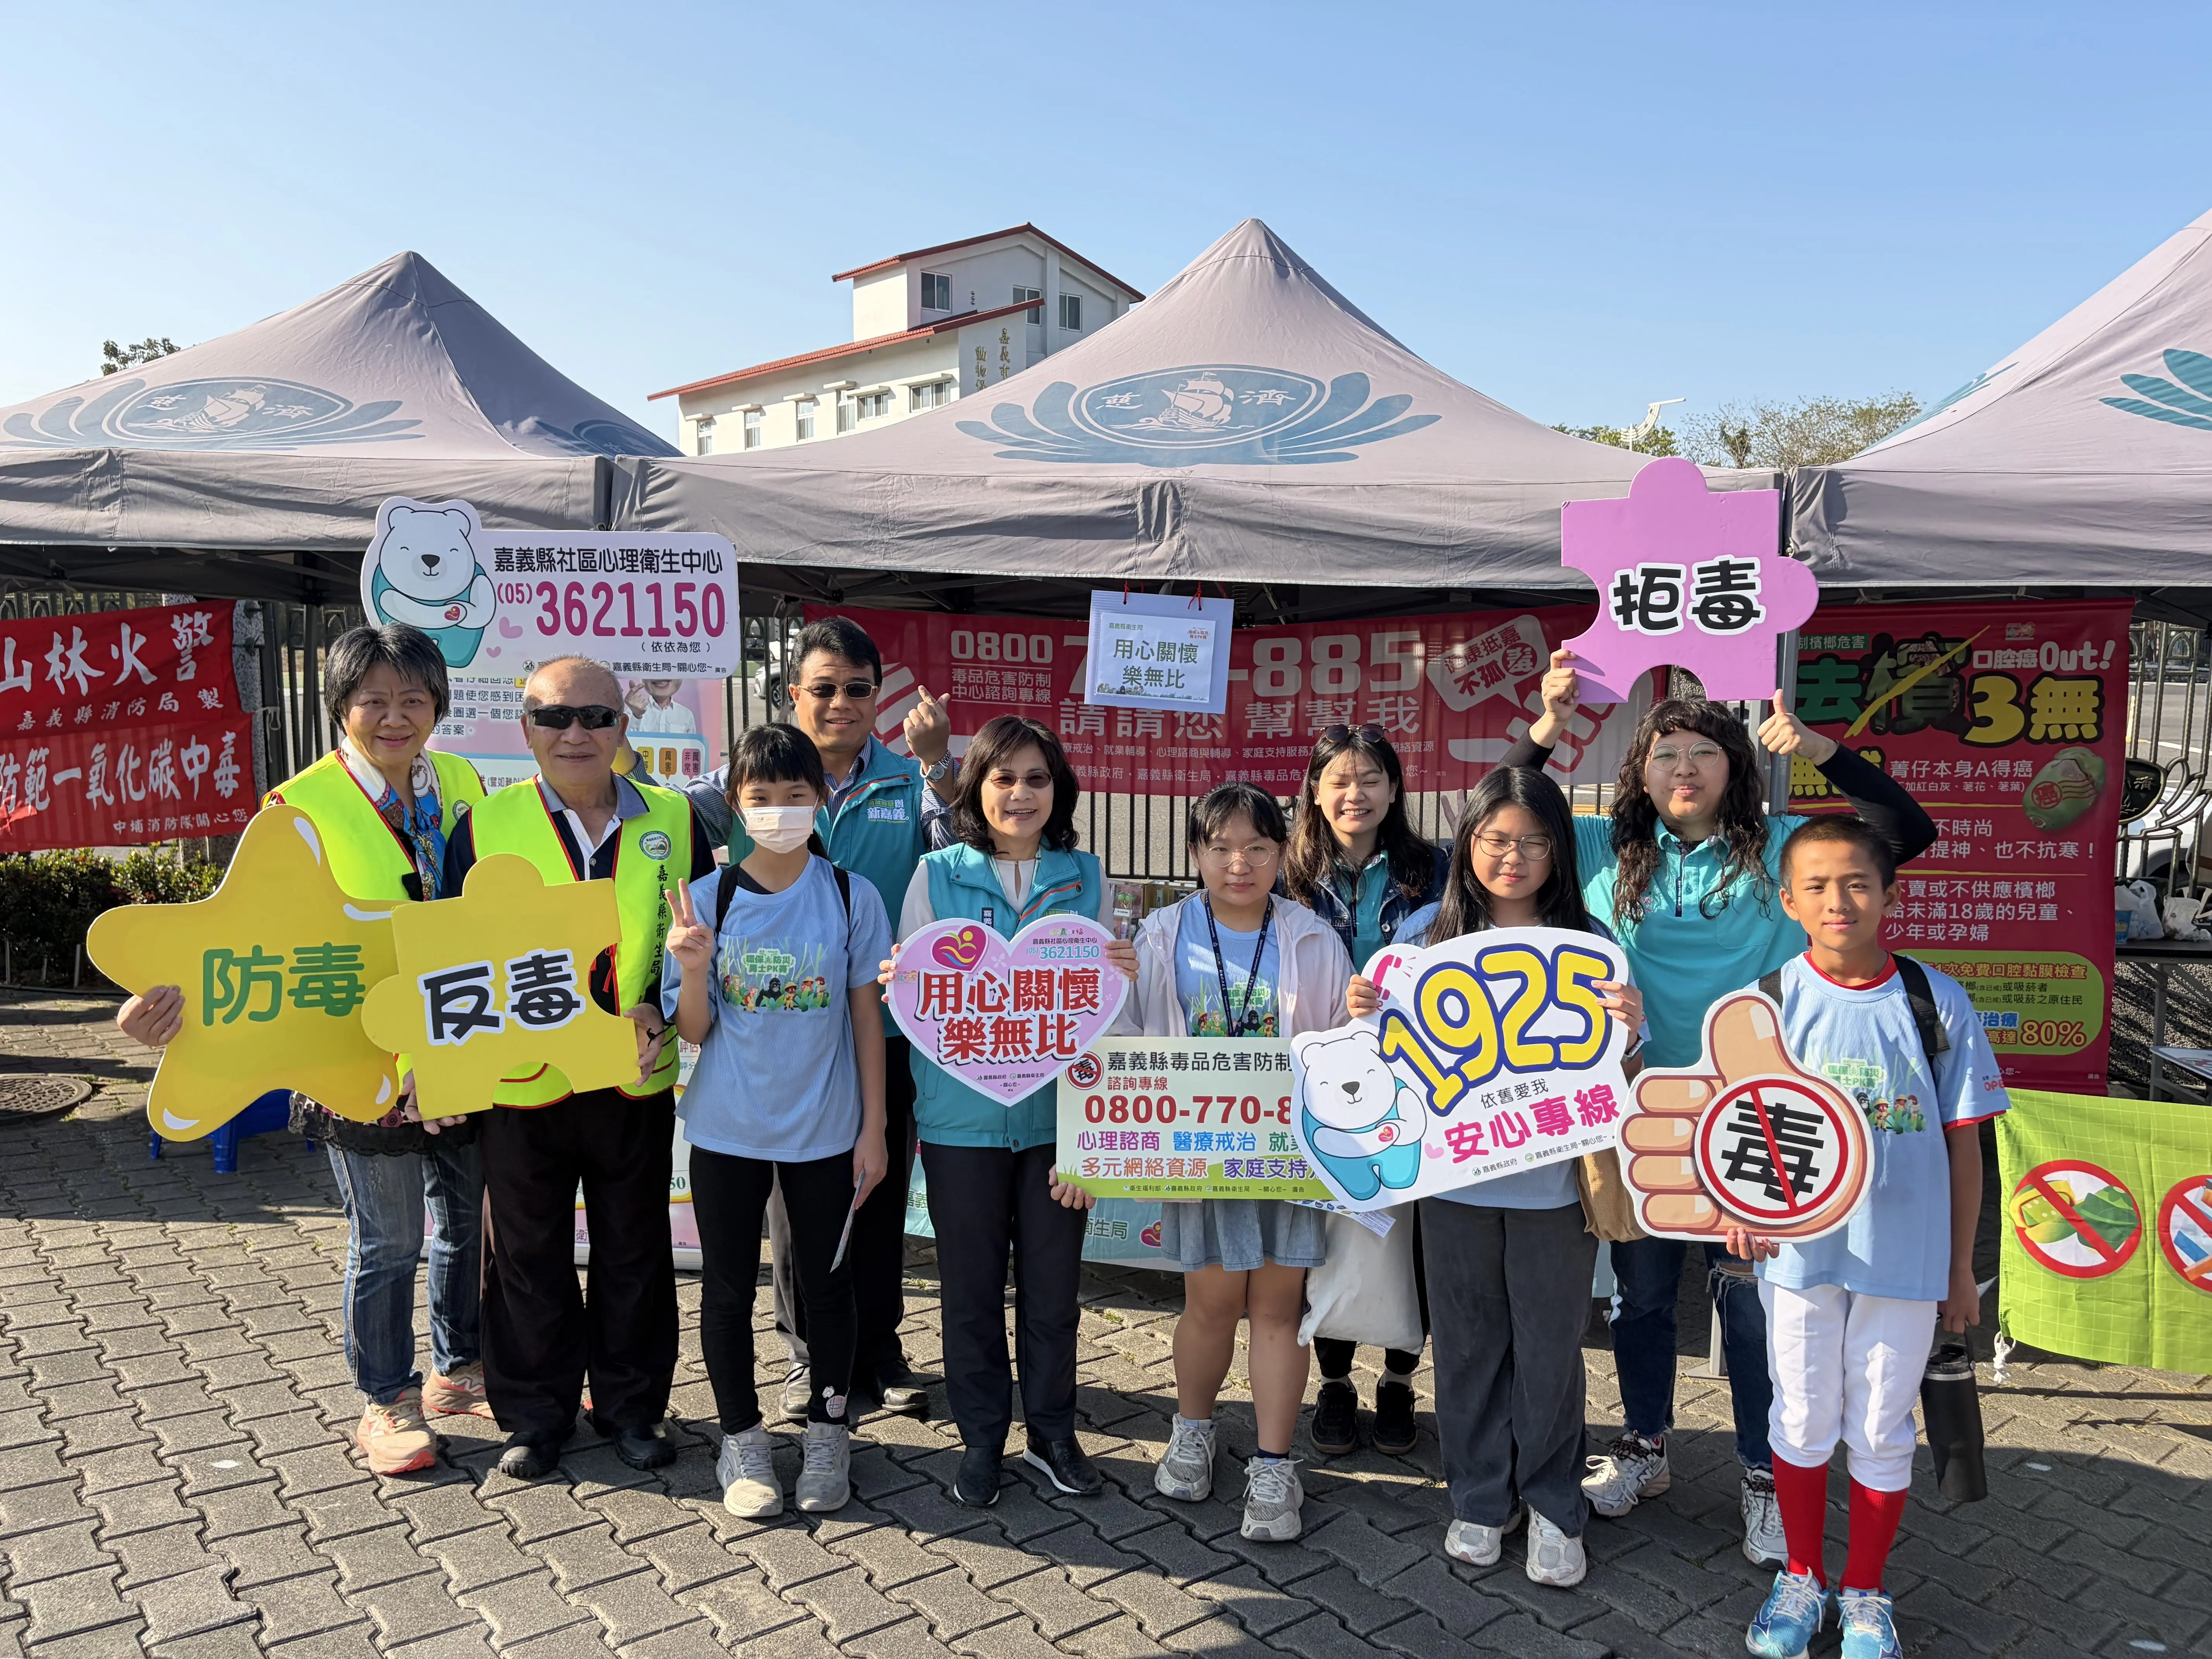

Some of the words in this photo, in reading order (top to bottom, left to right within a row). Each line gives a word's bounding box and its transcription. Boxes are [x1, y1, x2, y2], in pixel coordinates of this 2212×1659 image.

[1096, 393, 1141, 410] 慈
[1238, 389, 1296, 407] 濟
[494, 547, 723, 574] 嘉義縣社區心理衛生中心
[1613, 560, 1761, 630] 拒毒
[536, 580, 726, 638] 3621150
[1108, 622, 1144, 631] 嘉義縣衛生局
[0, 611, 214, 696] 山林火警
[951, 630, 1053, 663] 0800
[1113, 639, 1199, 664] 用心關懷
[951, 668, 1051, 688] 毒品危害防制
[1122, 665, 1185, 689] 樂無比
[951, 684, 1051, 703] 中心諮詢專線
[0, 730, 241, 813] 防範一氧化碳中毒
[665, 750, 672, 772] 厲害
[1890, 760, 2033, 778] 菁仔本身A得癌
[113, 809, 248, 835] 中埔消防隊關心您
[1917, 840, 2094, 860] 提神、也不抗寒!
[651, 864, 668, 976] 嘉義縣衛生局
[1885, 922, 1990, 942] 少年或孕婦
[1040, 945, 1100, 959] 3621150
[1923, 962, 2087, 979] 1次免費口腔黏膜檢查
[203, 942, 366, 1027] 防毒
[423, 953, 580, 1041] 反毒
[920, 967, 1101, 1016] 用心關懷
[943, 1013, 1078, 1060] 樂無比
[1379, 943, 1615, 1117] 1925
[1985, 1029, 2017, 1045] 高達
[2022, 1019, 2086, 1047] 80%
[680, 1042, 698, 1053] 評估
[1108, 1051, 1292, 1072] 嘉義縣毒品危害防制
[1108, 1076, 1168, 1091] 諮詢專線
[1480, 1078, 1549, 1109] 依舊愛我
[1444, 1084, 1620, 1164] 安心專線
[1077, 1131, 1160, 1152] 心理諮商
[1173, 1131, 1257, 1152] 醫療戒治
[1721, 1098, 1825, 1203] 毒
[1081, 1157, 1208, 1178] 多元網絡資源
[1482, 1158, 1517, 1174] 嘉義縣政府
